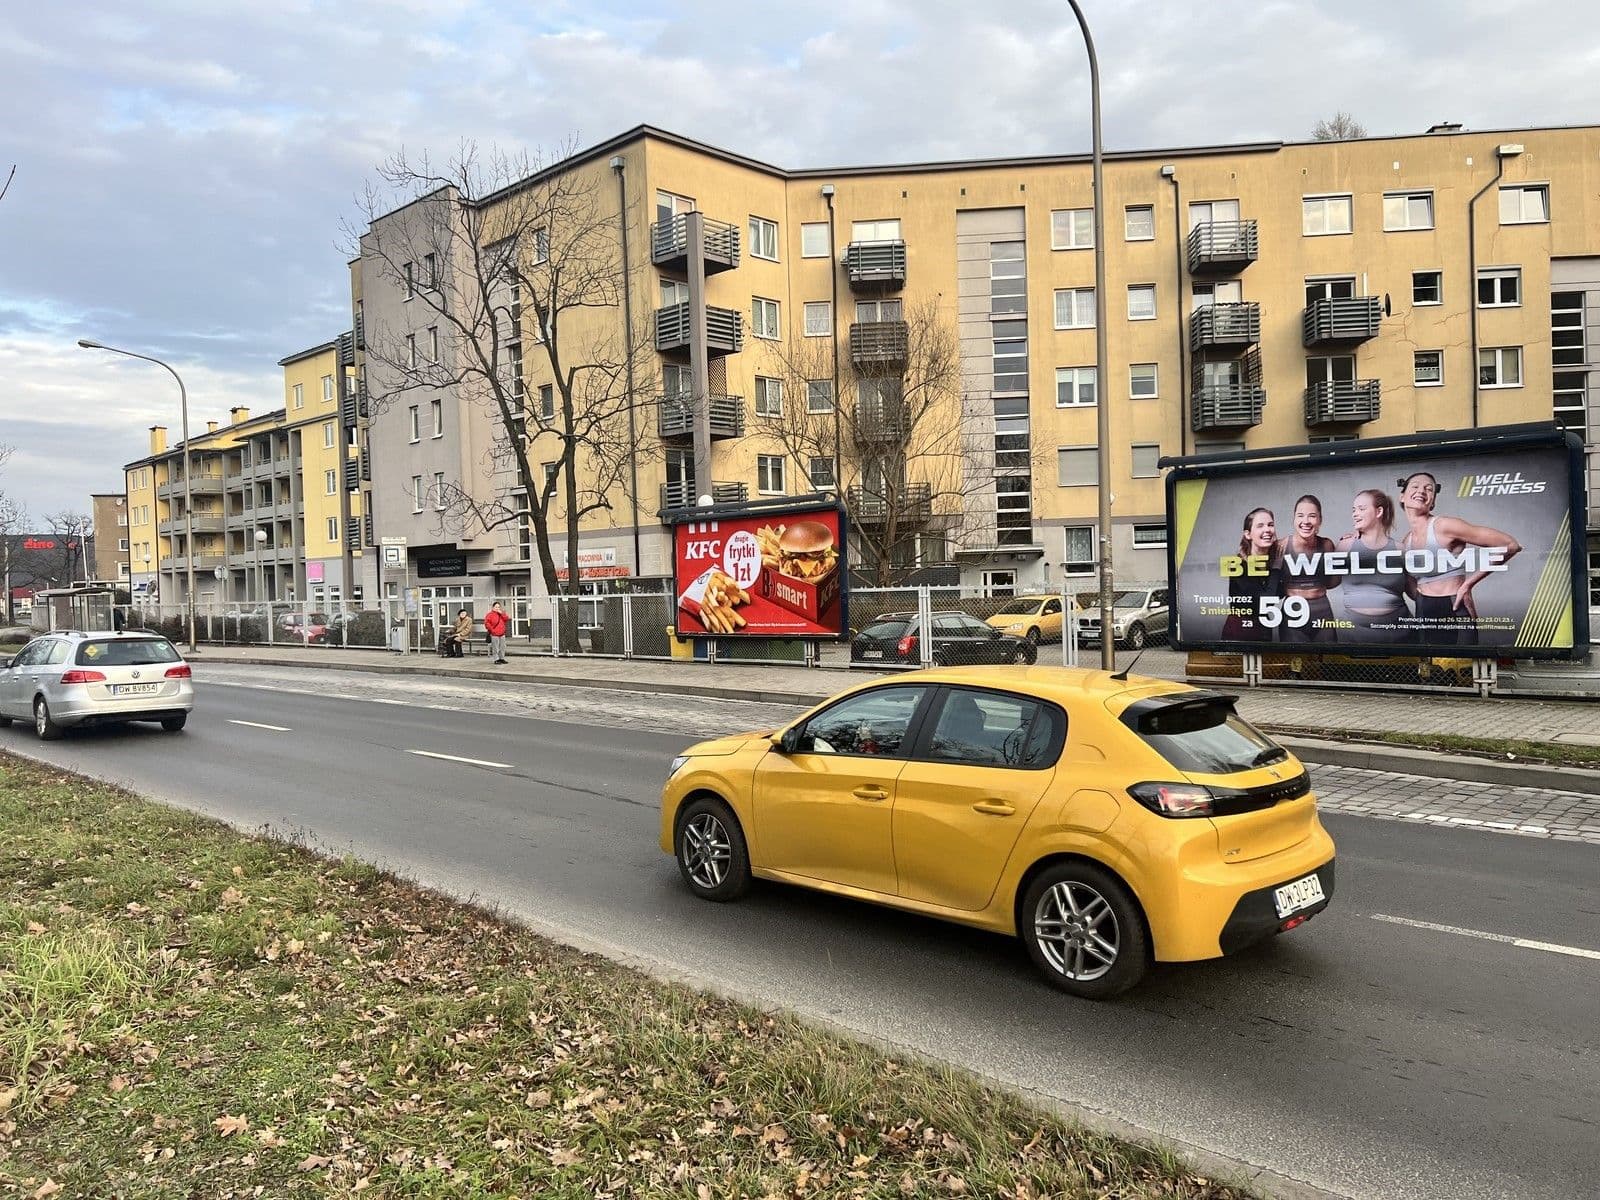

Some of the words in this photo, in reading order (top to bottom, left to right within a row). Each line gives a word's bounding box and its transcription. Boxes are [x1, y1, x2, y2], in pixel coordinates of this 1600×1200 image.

[1475, 472, 1525, 485] WELL
[1469, 481, 1546, 497] FITNESS
[685, 540, 721, 560] KFC
[729, 543, 755, 561] frytki
[1219, 555, 1270, 577] BE
[1283, 546, 1509, 577] WELCOME
[777, 582, 808, 610] smart
[1193, 594, 1224, 605] Trenuj
[1226, 595, 1253, 605] przez
[1200, 607, 1207, 616] 3
[1208, 606, 1253, 617] miesiące
[1242, 619, 1253, 628] za
[1258, 595, 1311, 629] 59
[1312, 617, 1356, 629] zł/mies.
[1398, 616, 1424, 624] Promocja
[118, 685, 130, 694] DW
